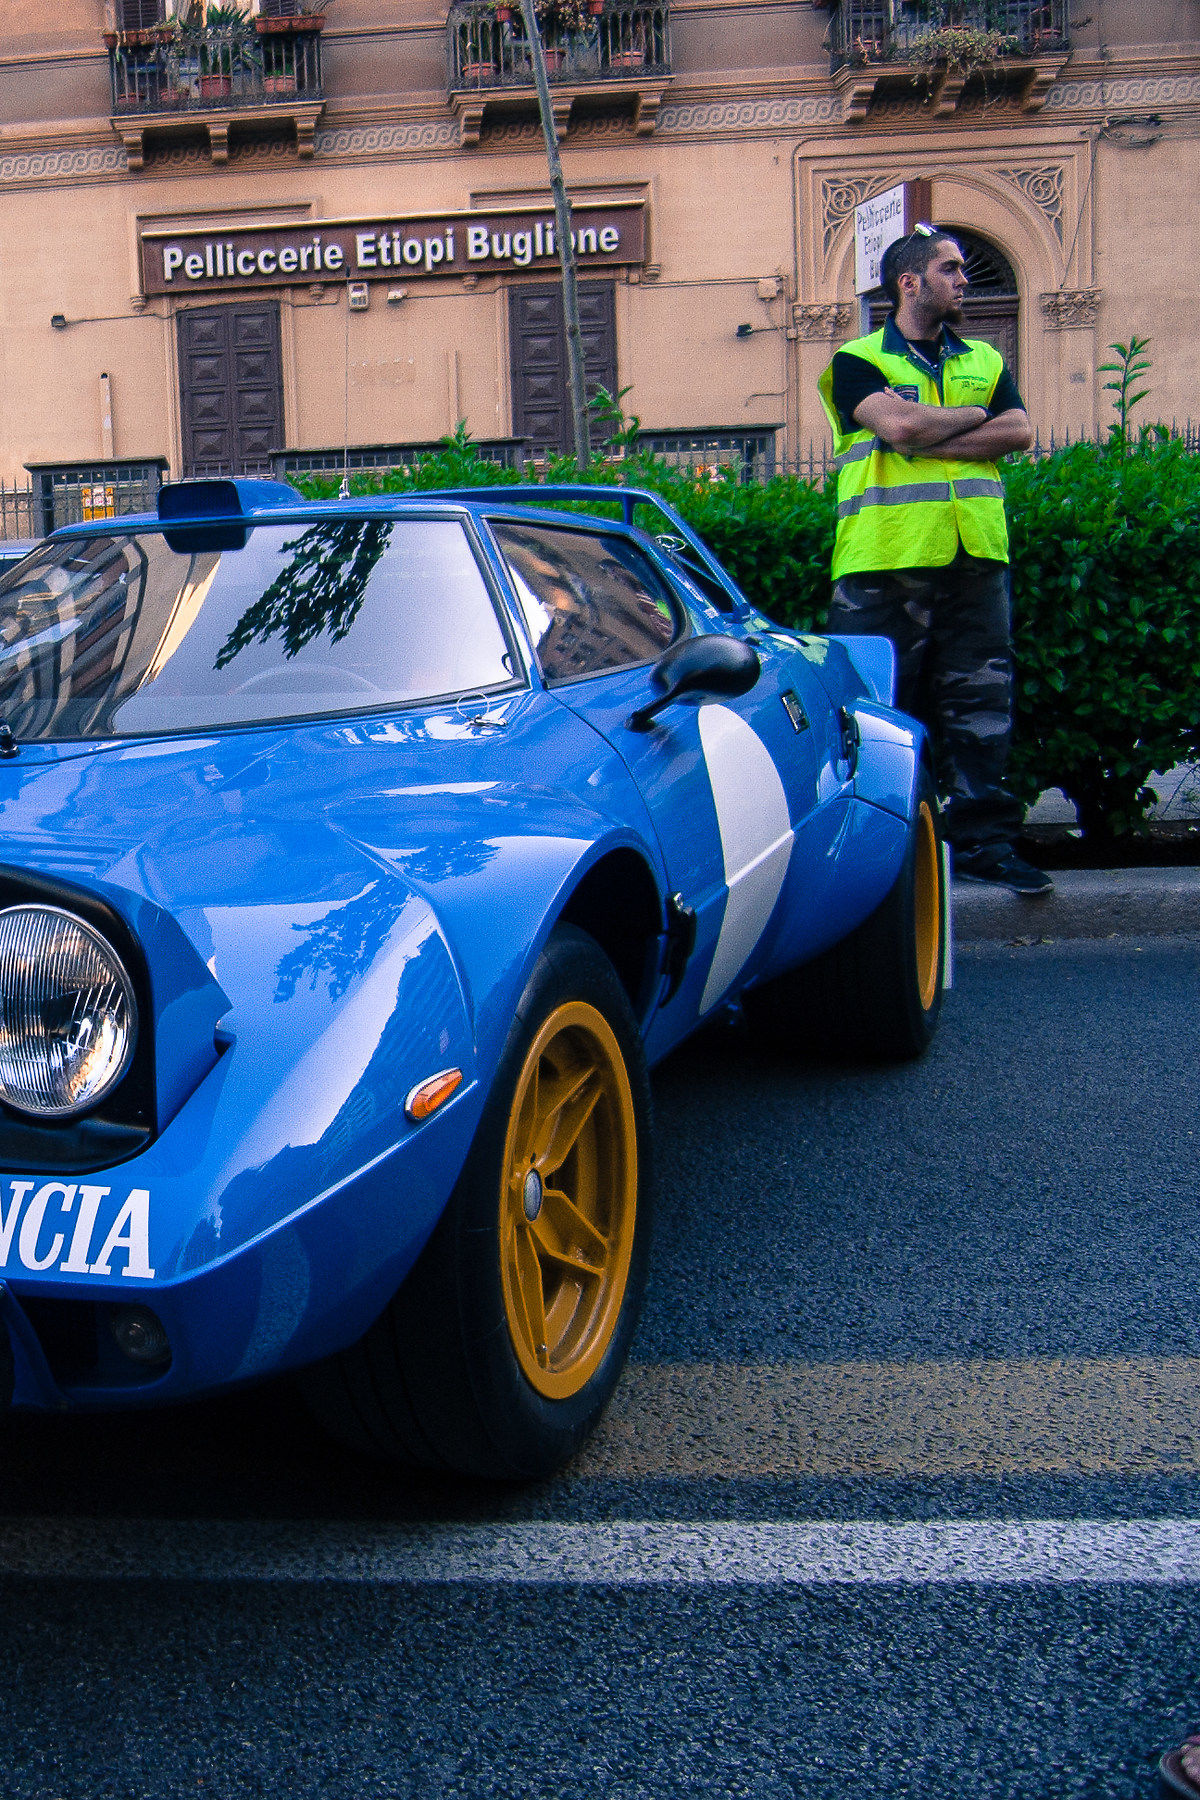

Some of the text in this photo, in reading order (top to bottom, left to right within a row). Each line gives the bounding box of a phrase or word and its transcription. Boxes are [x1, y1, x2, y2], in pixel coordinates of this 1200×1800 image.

[163, 222, 620, 281] Pelliccerie Etiopi Bugline
